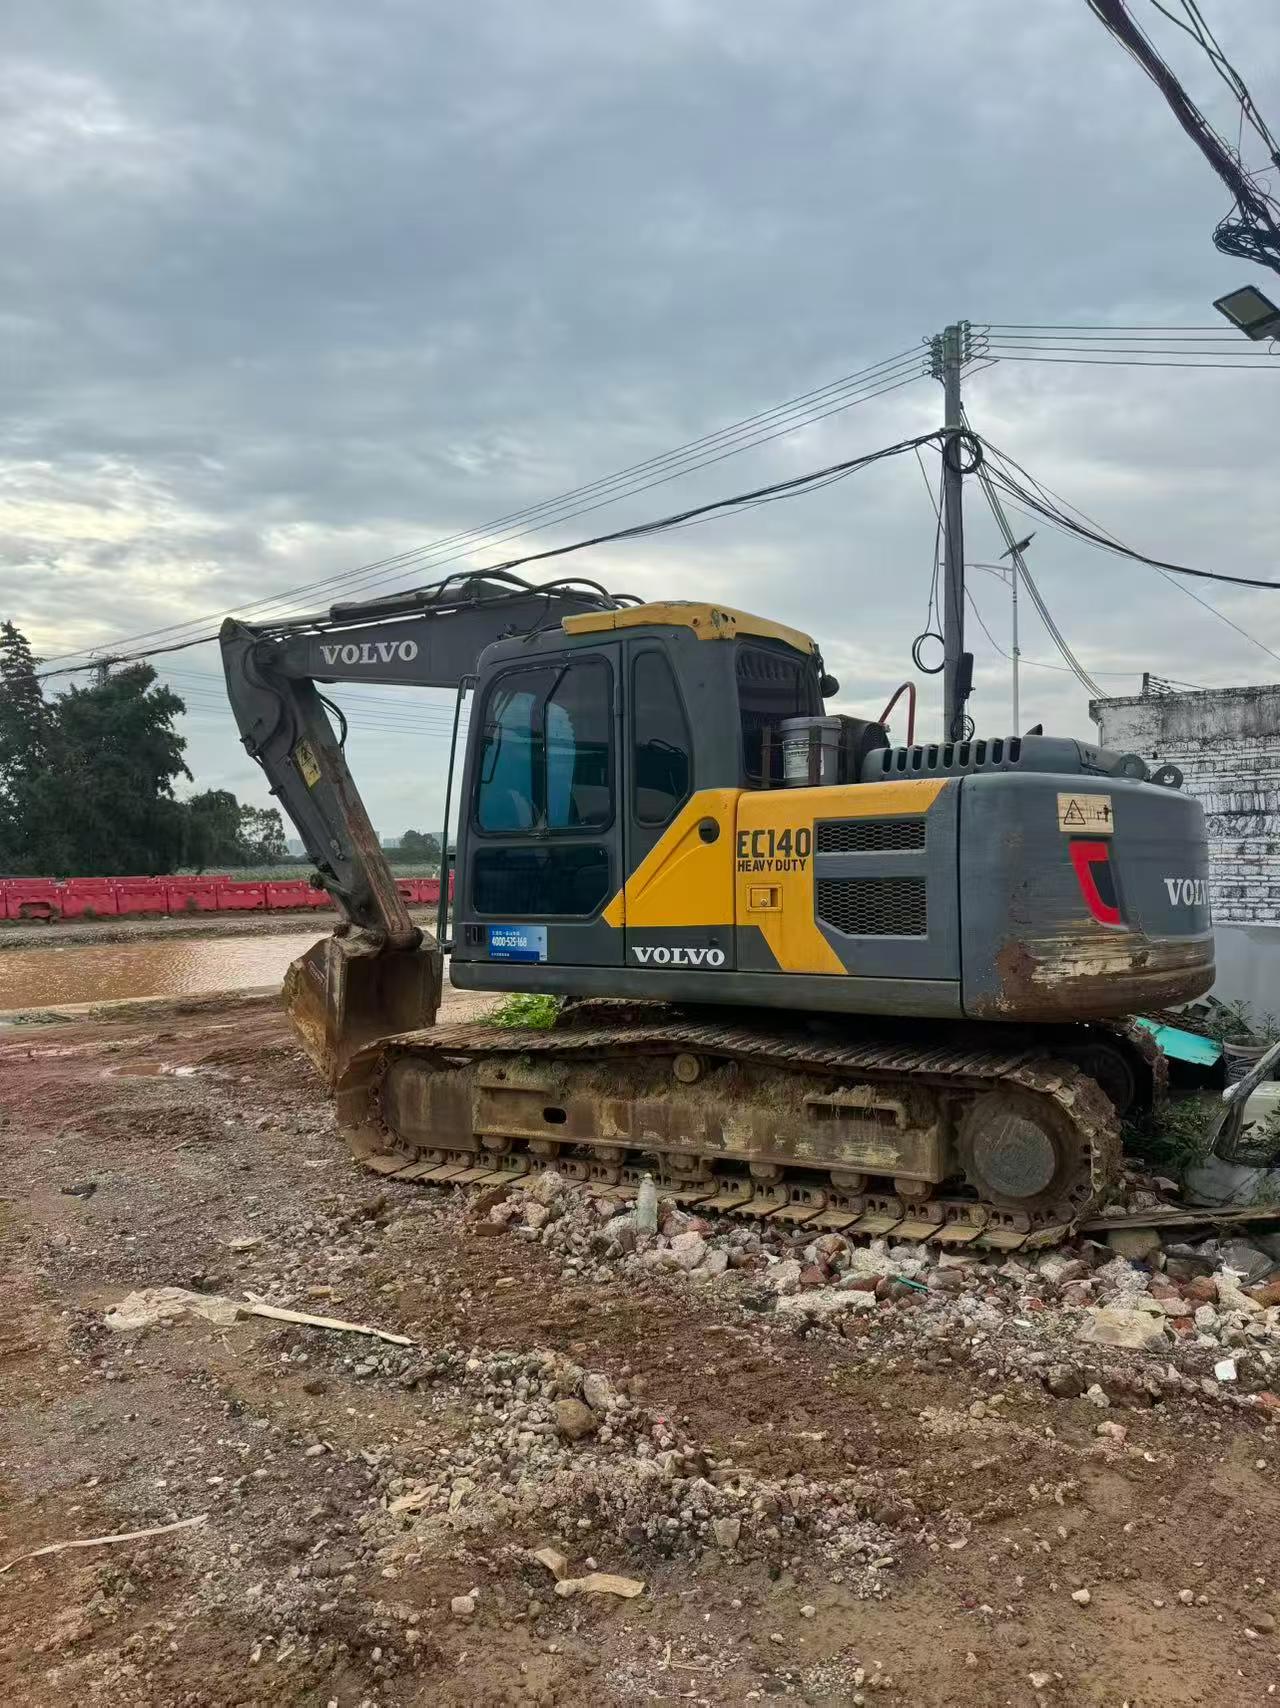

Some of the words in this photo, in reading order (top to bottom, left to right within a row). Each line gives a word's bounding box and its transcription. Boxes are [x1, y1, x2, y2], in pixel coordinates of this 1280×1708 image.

[320, 640, 418, 665] VOLVO
[737, 828, 811, 858] EC140
[737, 859, 774, 872] HEAVY
[775, 859, 806, 872] DUTY
[1164, 879, 1209, 905] VOLV
[632, 947, 725, 966] VOLVO
